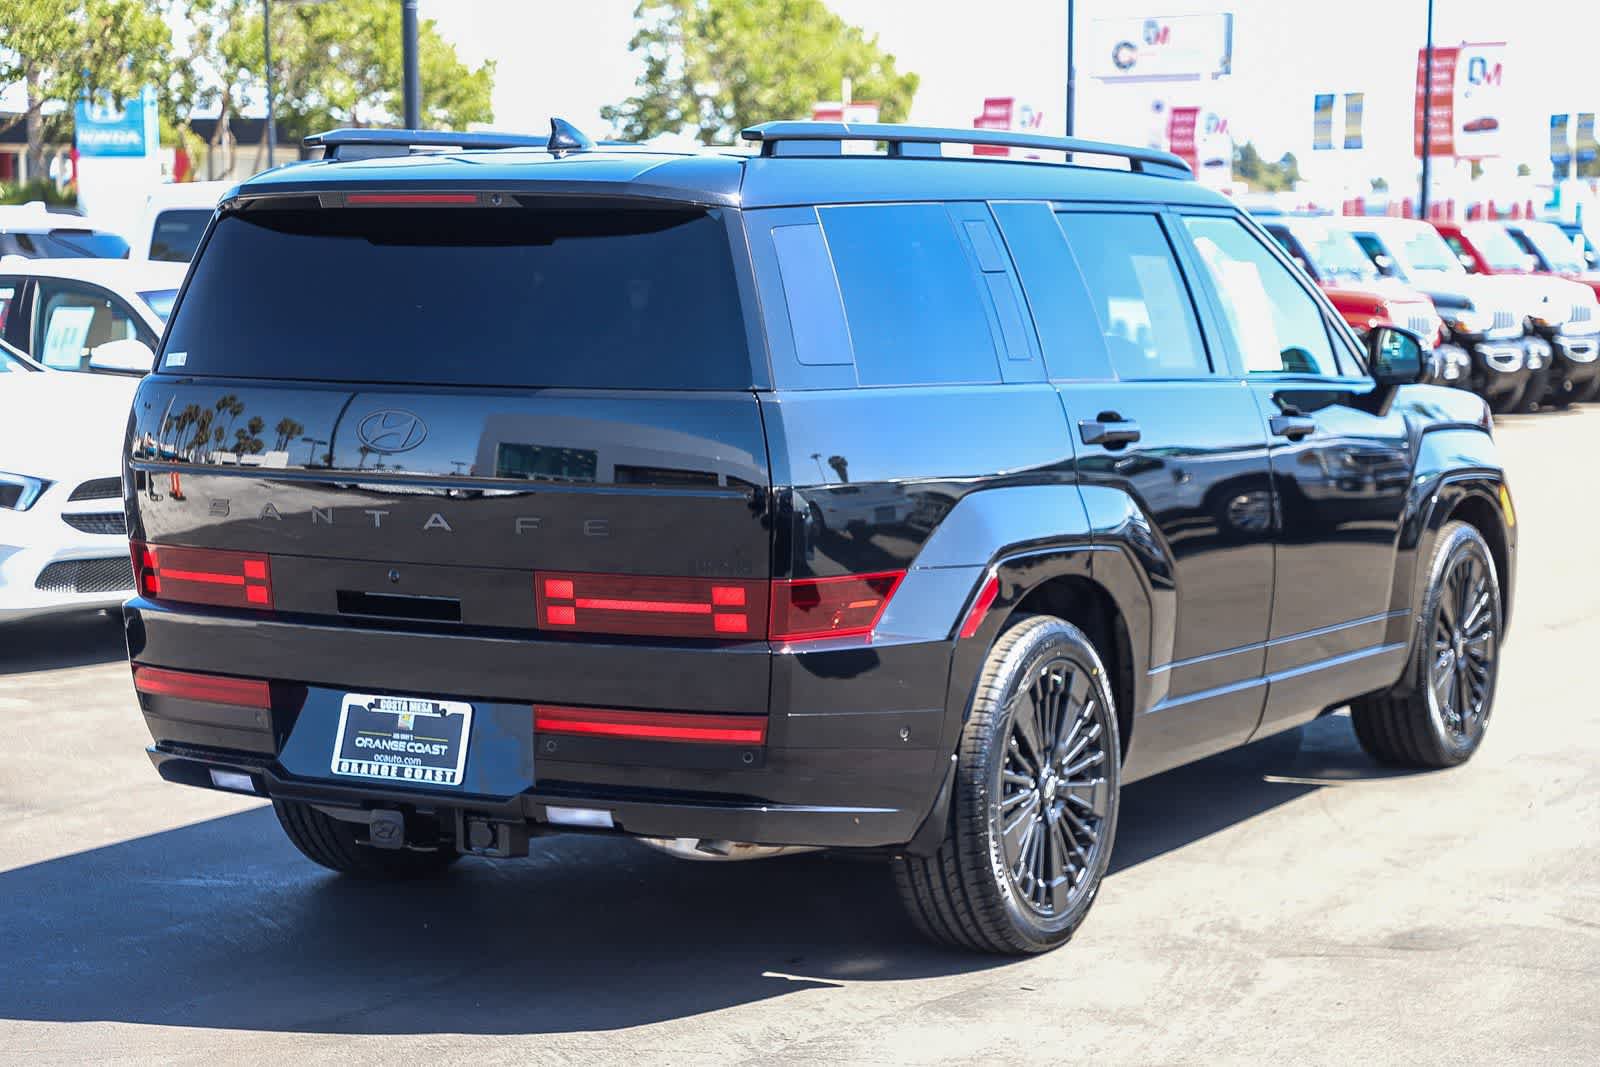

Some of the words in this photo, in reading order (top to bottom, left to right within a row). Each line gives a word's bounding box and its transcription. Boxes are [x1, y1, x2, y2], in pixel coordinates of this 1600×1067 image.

[208, 497, 453, 532] SANTA
[514, 516, 609, 536] FE
[380, 699, 407, 712] COSTA
[409, 701, 433, 713] MESA
[374, 753, 422, 766] ocauto.com
[340, 762, 397, 777] ORANGE
[404, 768, 453, 783] COAST
